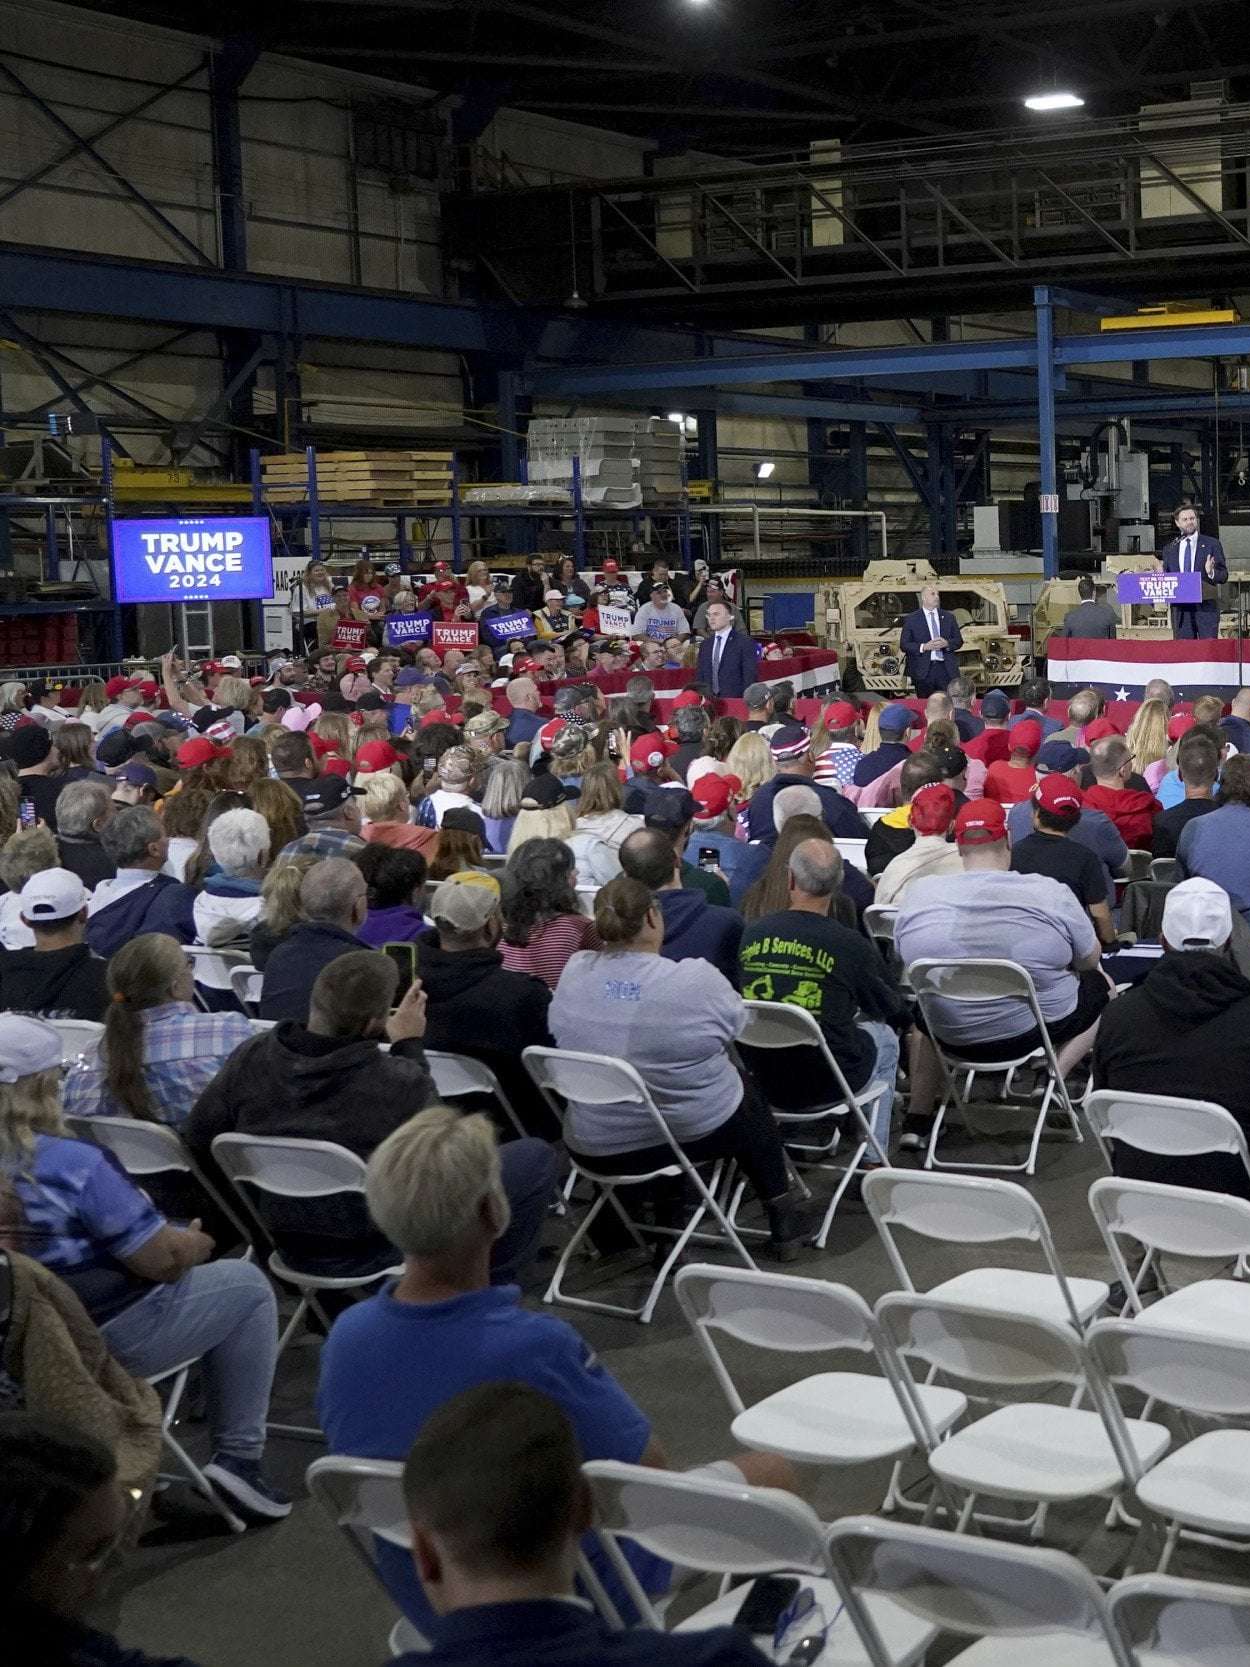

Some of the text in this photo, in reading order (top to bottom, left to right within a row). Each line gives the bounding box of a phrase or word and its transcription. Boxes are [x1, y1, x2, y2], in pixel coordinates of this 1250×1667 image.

[141, 532, 244, 553] TRUMP
[145, 553, 243, 573] VANCE
[169, 574, 222, 588] 2024
[1139, 581, 1178, 592] TRUMP
[601, 612, 629, 623] TRUMP
[647, 618, 676, 626] TRUMP
[390, 619, 430, 630] TRUMP
[492, 617, 529, 630] TRUMP
[337, 626, 366, 635] TRUMP
[394, 627, 427, 635] VANCE
[435, 628, 476, 637] TRUMP
[499, 625, 526, 634] VANCE
[338, 634, 361, 642] VANCE
[440, 635, 472, 643] VANCE
[762, 937, 771, 954] B
[771, 936, 814, 964] Services,
[816, 949, 835, 973] LLC
